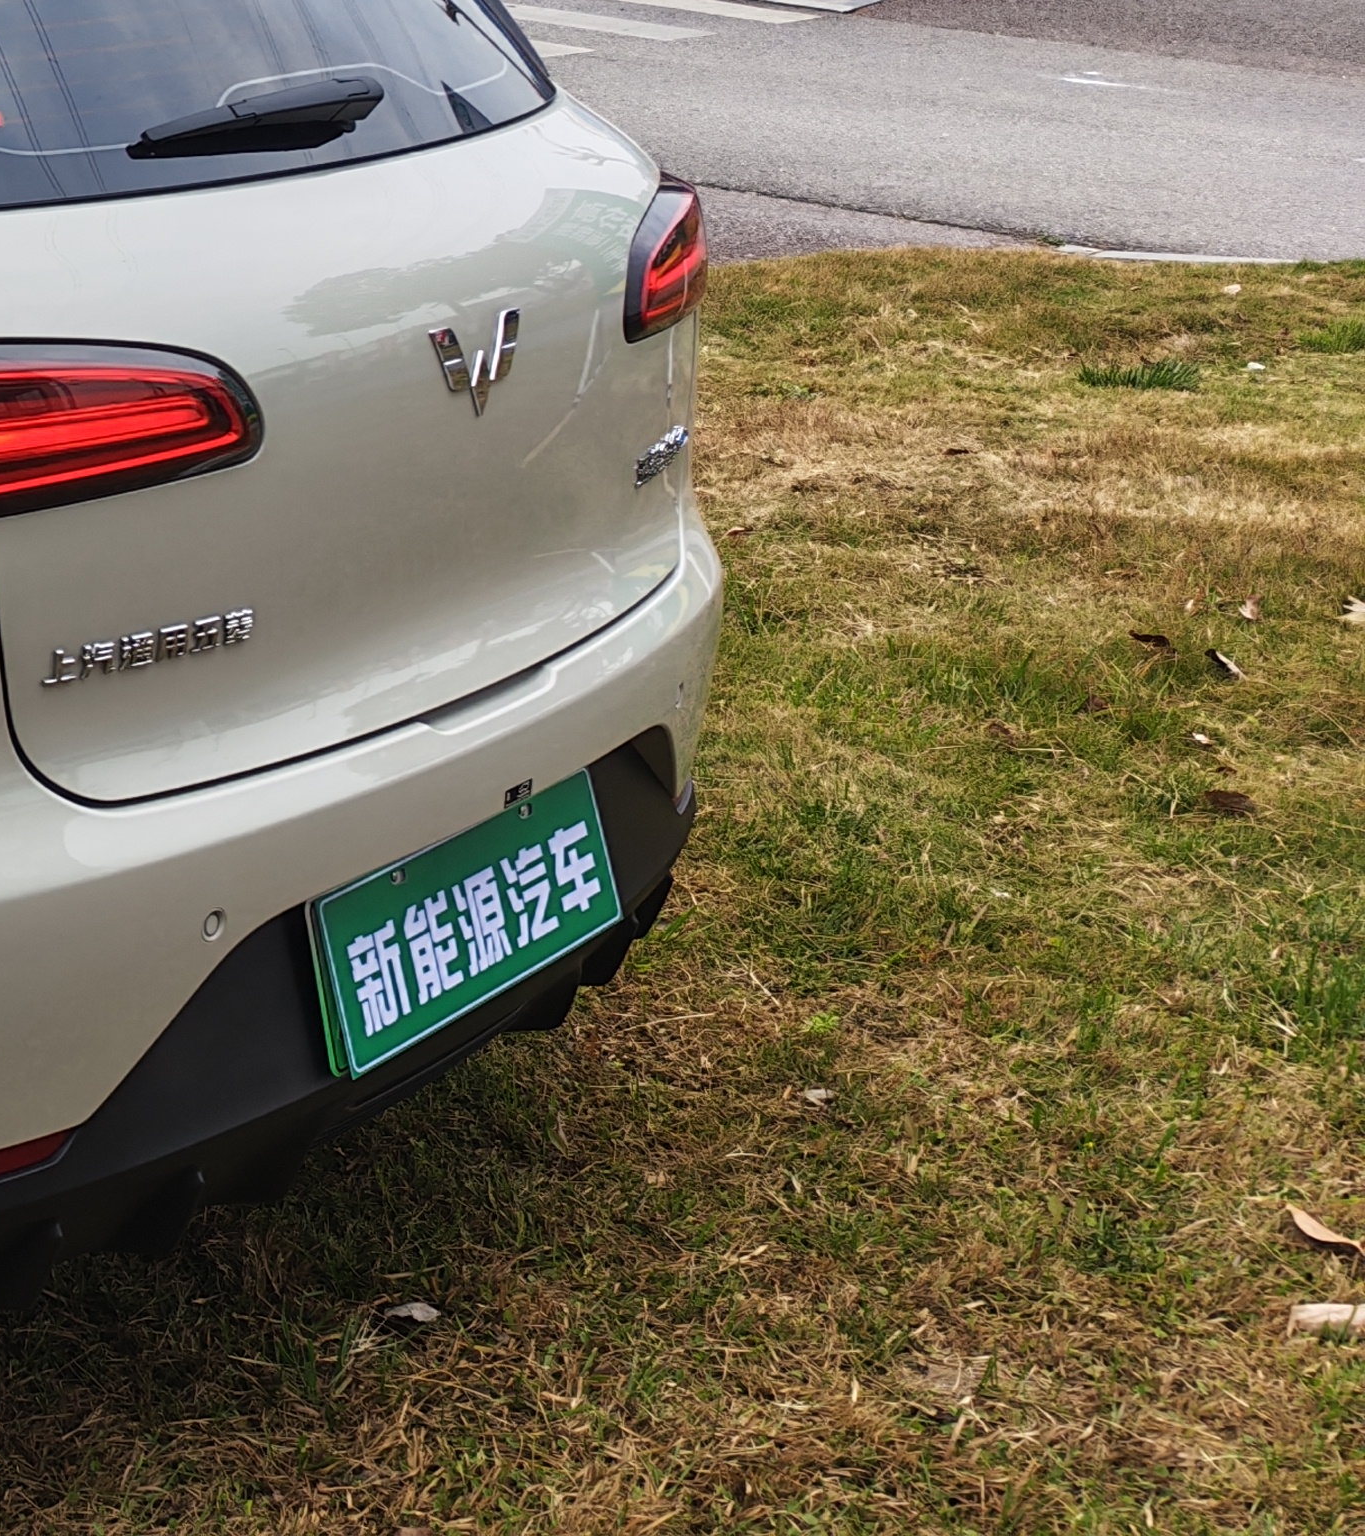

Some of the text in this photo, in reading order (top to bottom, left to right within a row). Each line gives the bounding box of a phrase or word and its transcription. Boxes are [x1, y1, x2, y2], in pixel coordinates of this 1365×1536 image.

[41, 609, 253, 687] 上汽通用五菱
[346, 820, 601, 1037] 新能源汽车
